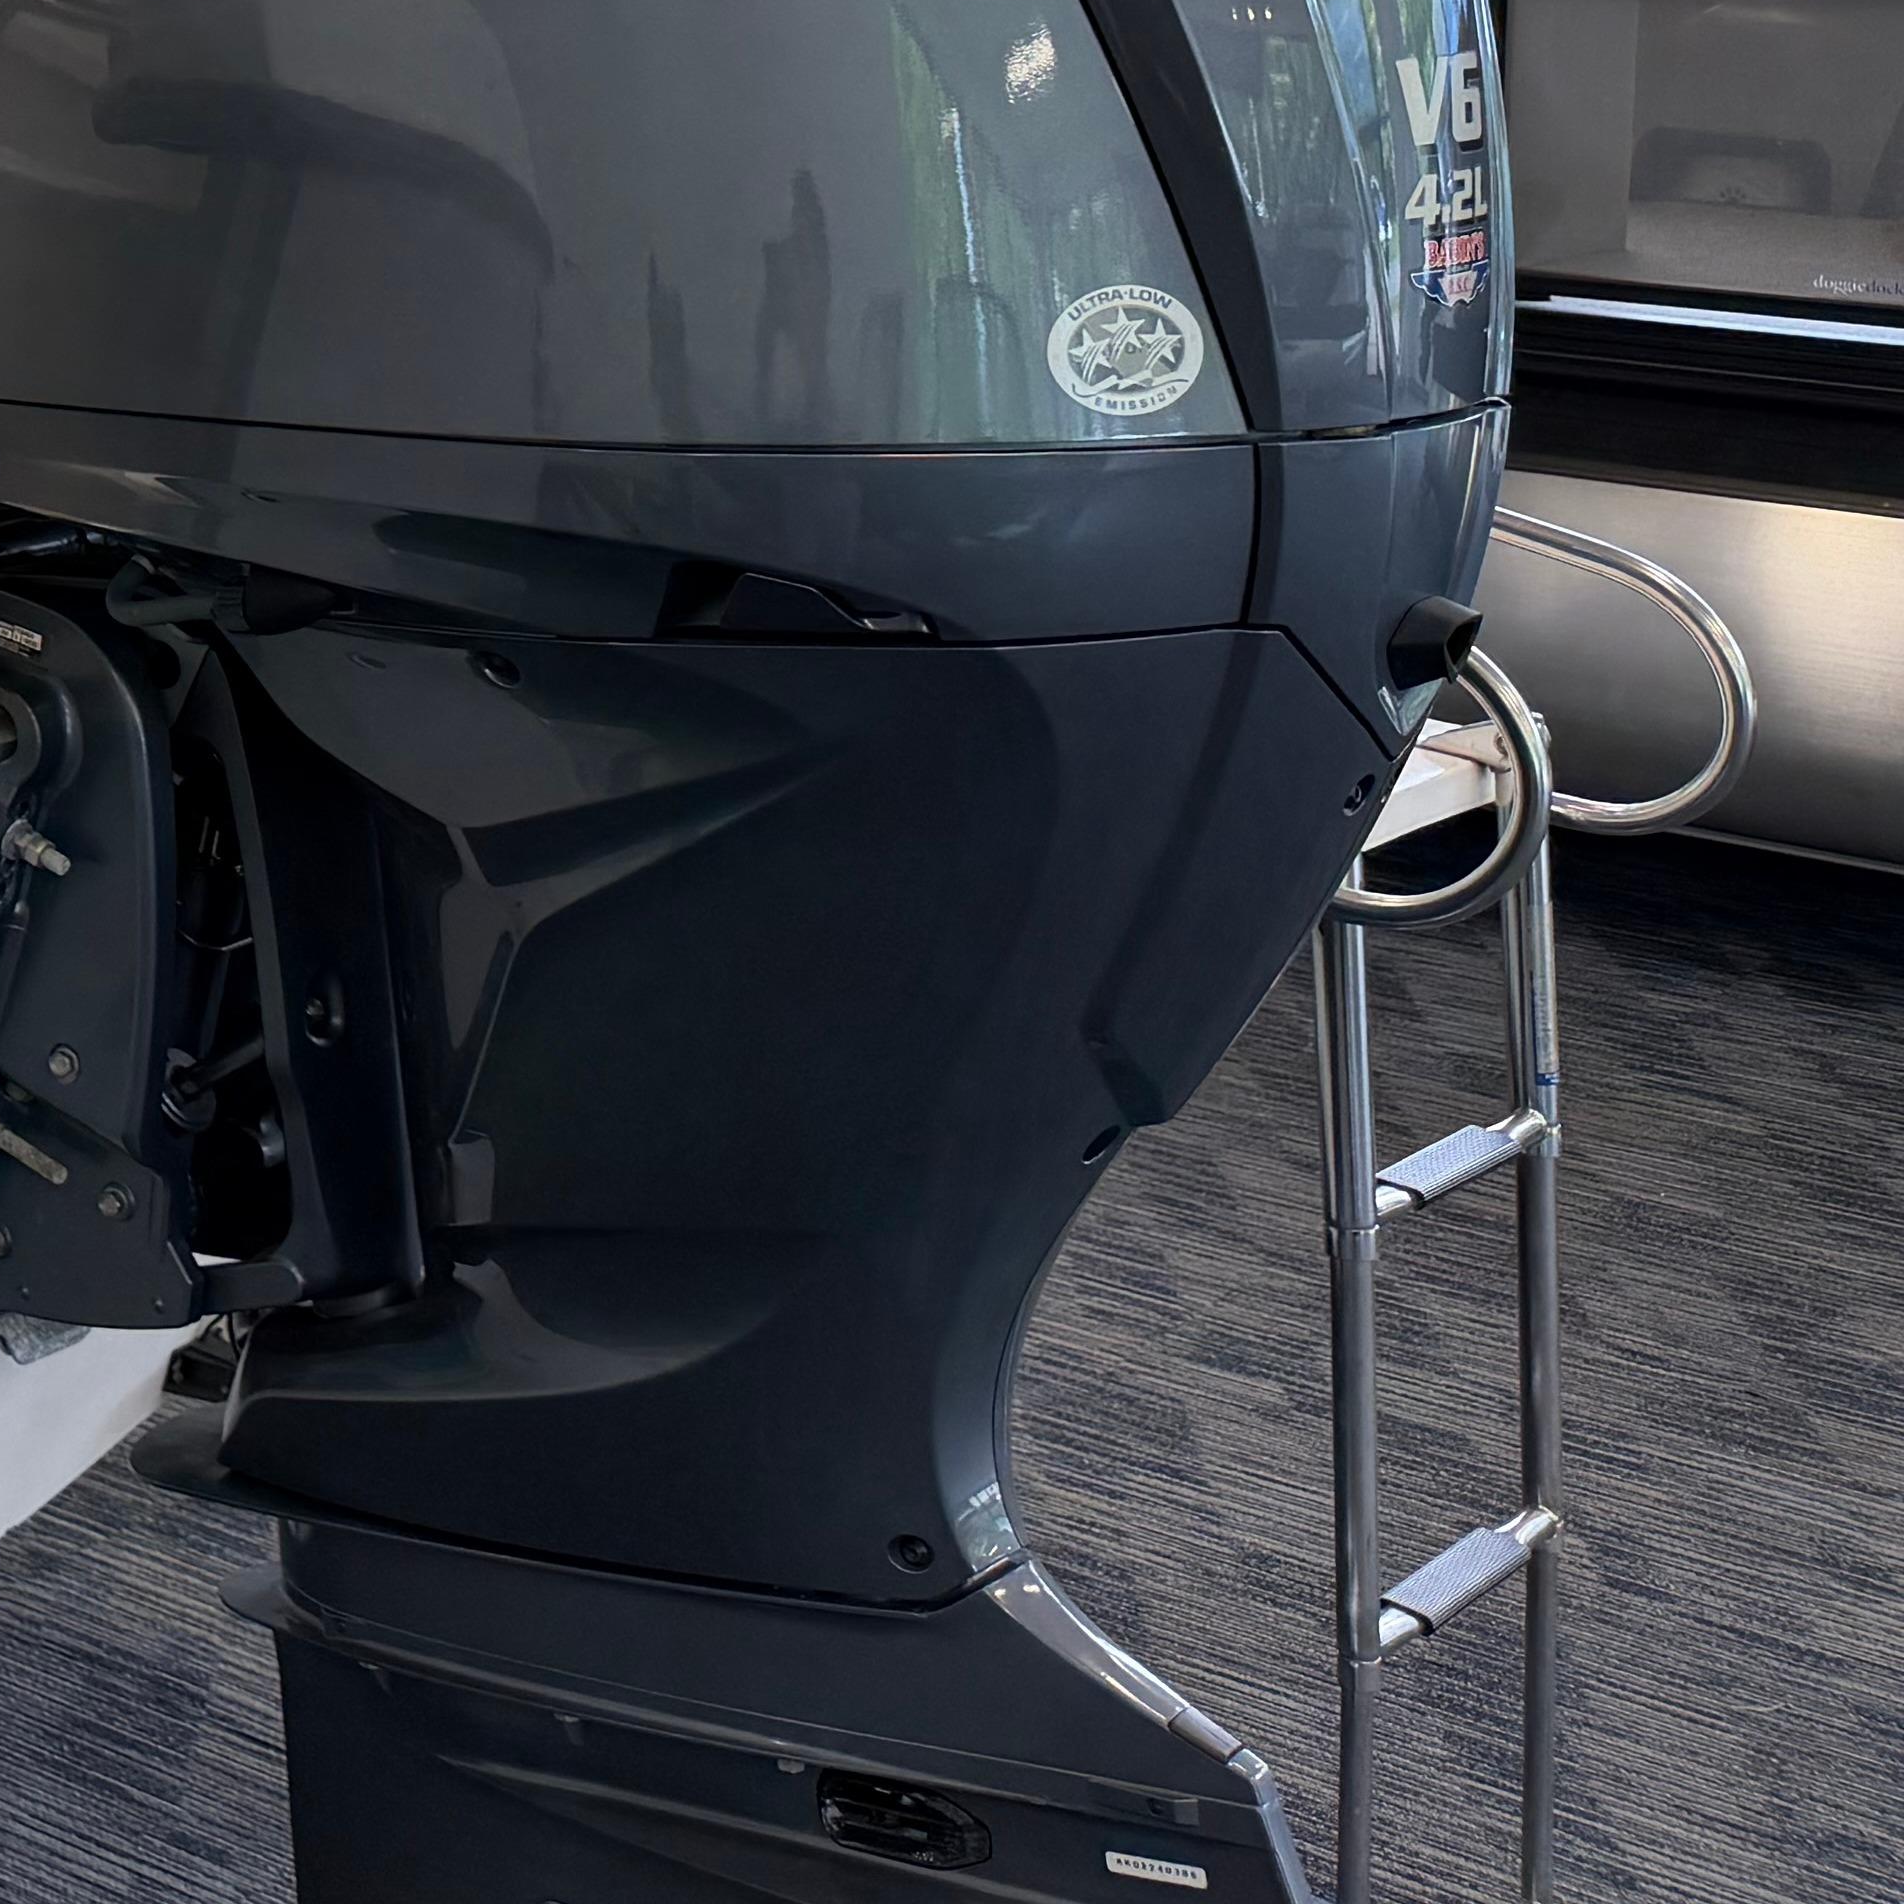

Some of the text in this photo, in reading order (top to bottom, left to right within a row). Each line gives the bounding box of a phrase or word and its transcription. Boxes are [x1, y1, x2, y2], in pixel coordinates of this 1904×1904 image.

[1395, 50, 1483, 146] V6
[1404, 165, 1488, 226] 4.2L
[1094, 385, 1178, 411] EMISSION
